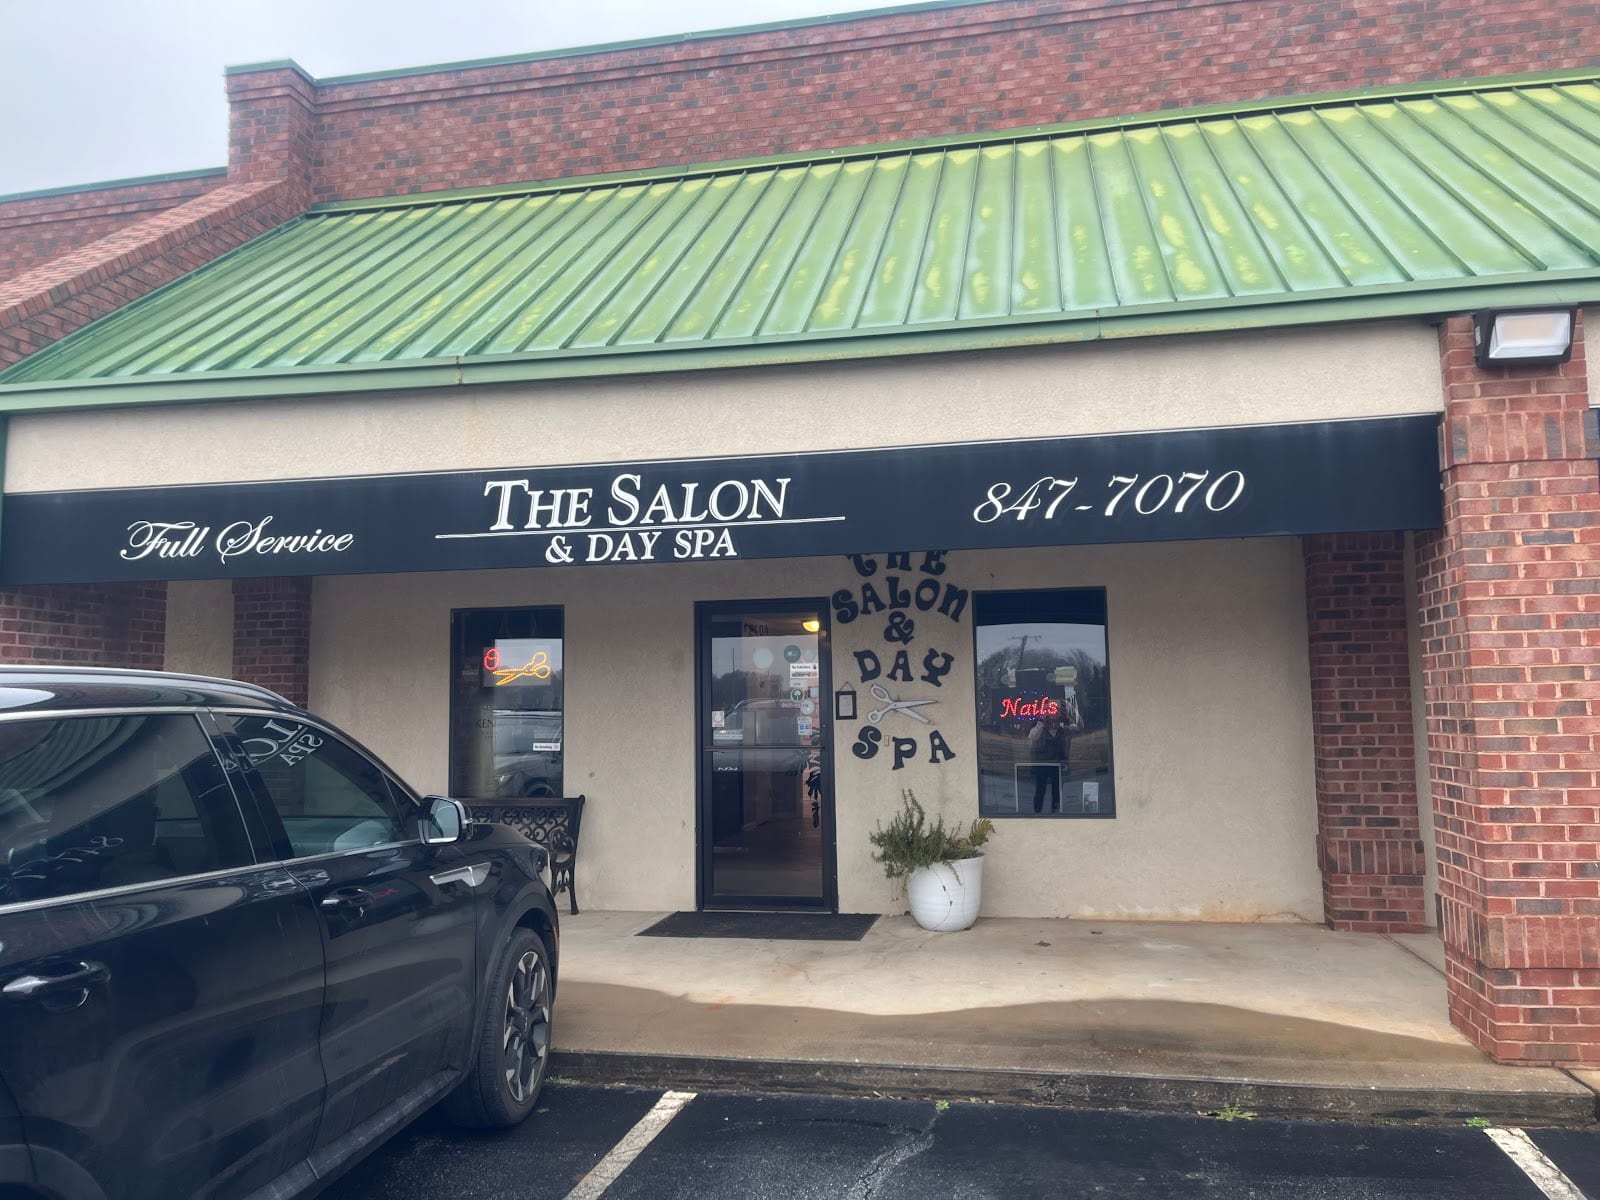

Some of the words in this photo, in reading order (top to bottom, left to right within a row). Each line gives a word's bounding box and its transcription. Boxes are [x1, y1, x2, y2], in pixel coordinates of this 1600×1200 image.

[484, 479, 593, 531] THE
[607, 473, 792, 527] SALON
[973, 470, 1245, 523] 847-7070
[120, 520, 210, 560] Full
[216, 515, 354, 564] Service
[545, 535, 574, 563] &
[586, 531, 662, 562] DAY
[673, 527, 738, 558] SPA
[831, 576, 969, 624] SALON
[883, 611, 915, 645] &
[853, 648, 955, 688] DAY
[1000, 696, 1059, 718] Nails
[852, 725, 956, 771] SPA
